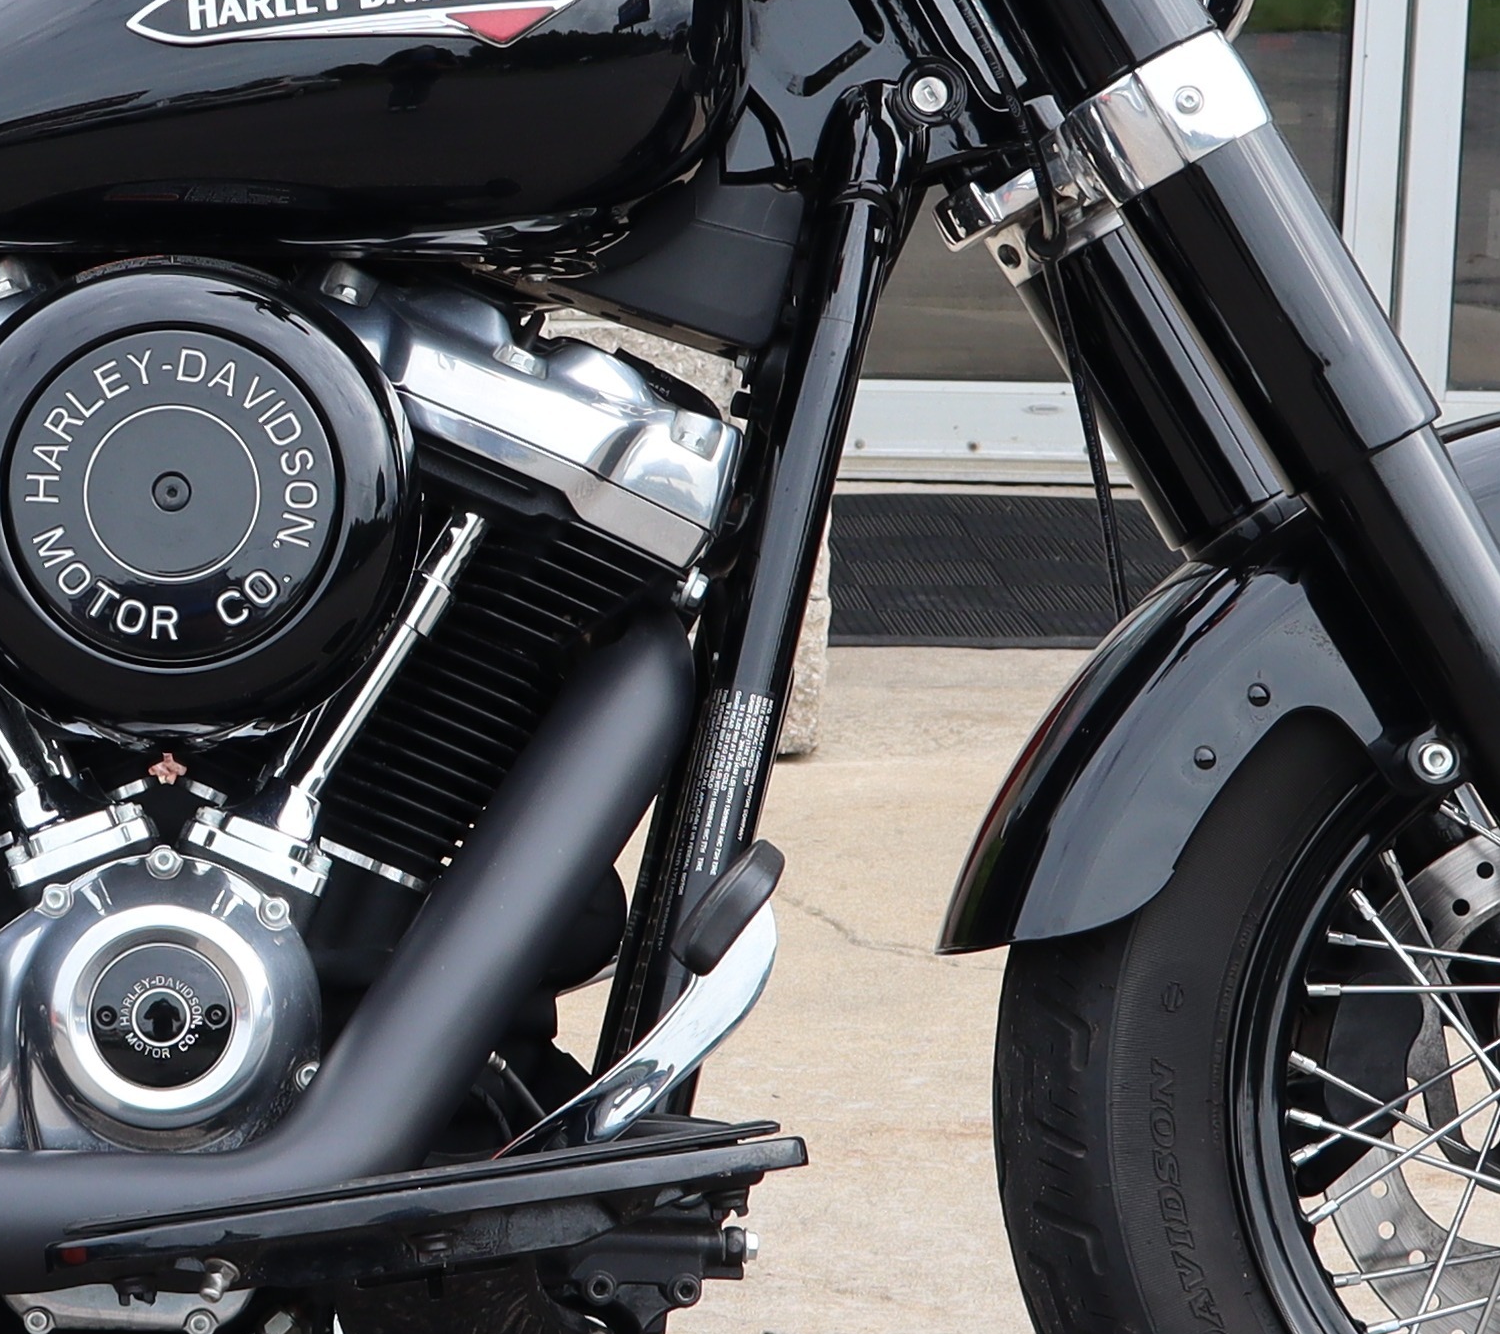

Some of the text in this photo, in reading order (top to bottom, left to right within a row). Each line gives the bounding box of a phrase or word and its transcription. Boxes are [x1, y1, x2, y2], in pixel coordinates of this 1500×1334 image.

[32, 524, 292, 641] MOTOR CO.
[125, 1033, 199, 1059] MOTOR CO.
